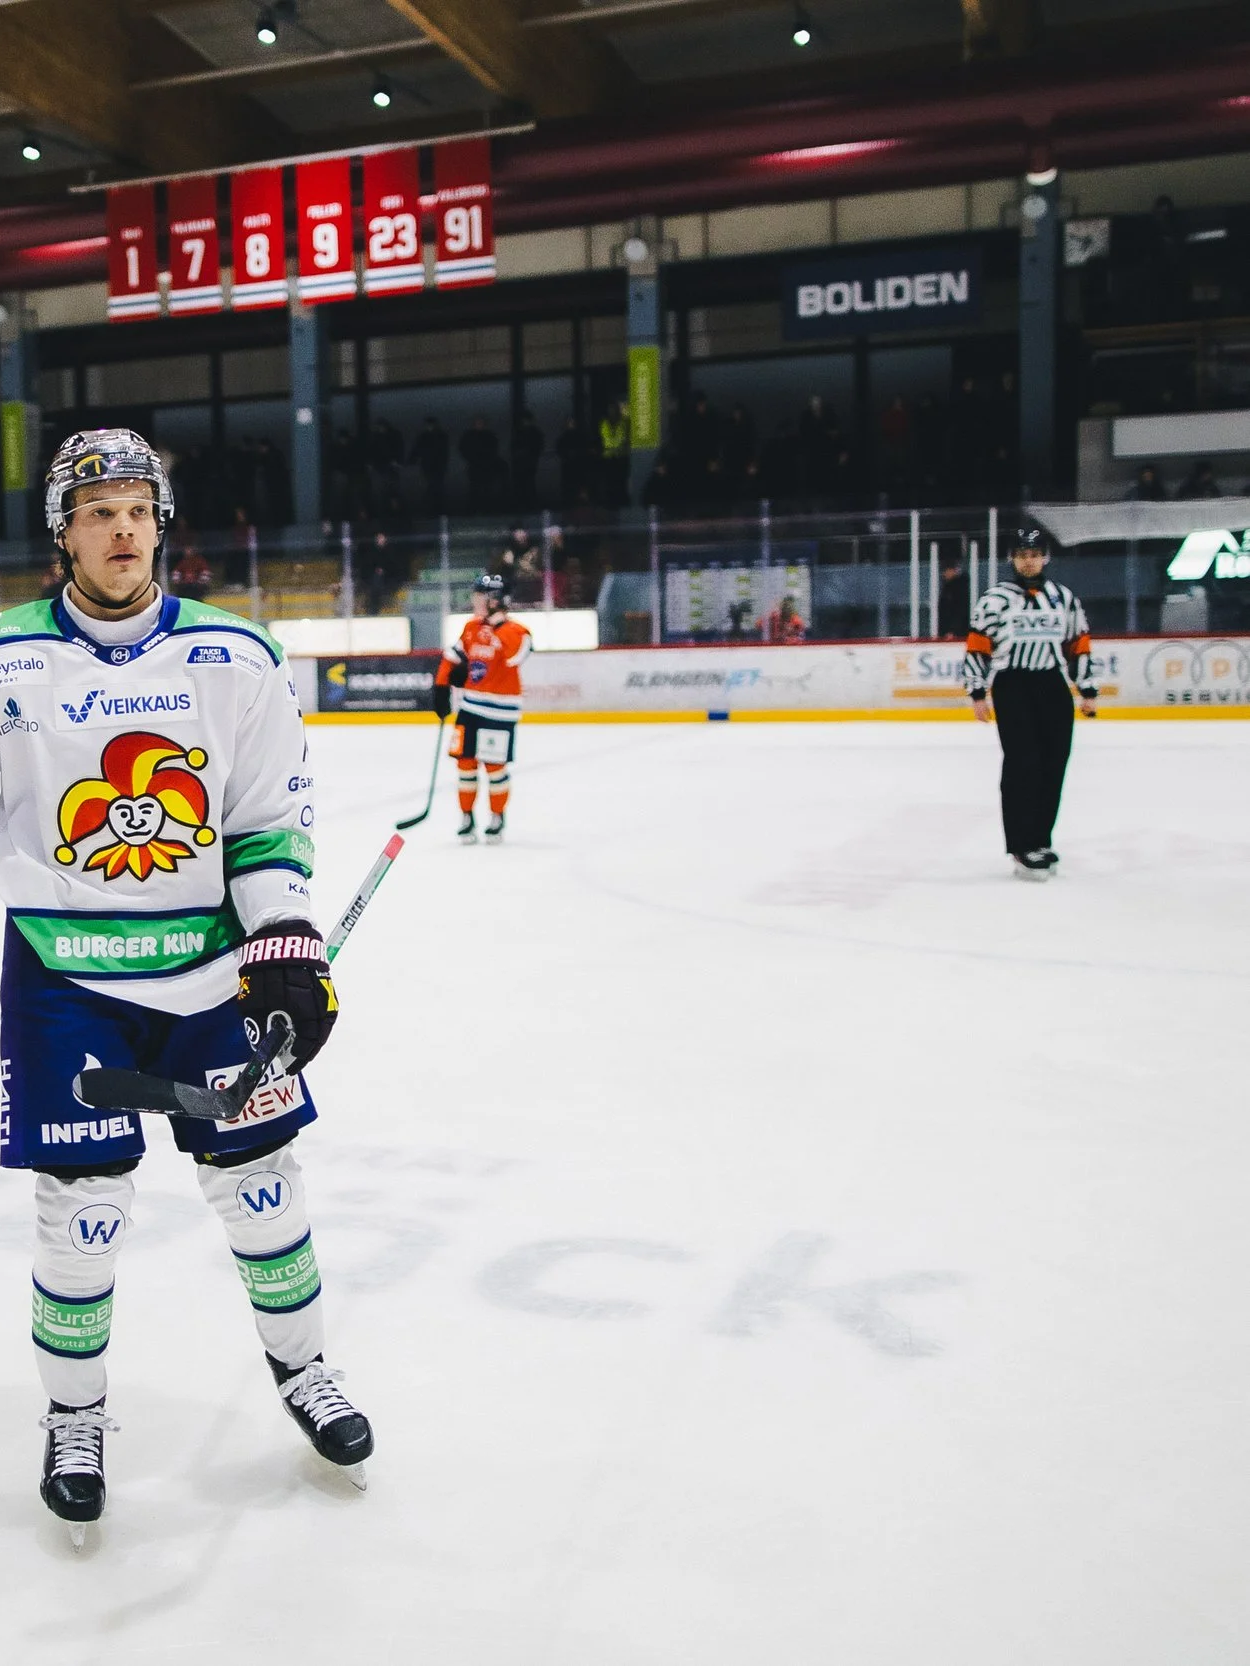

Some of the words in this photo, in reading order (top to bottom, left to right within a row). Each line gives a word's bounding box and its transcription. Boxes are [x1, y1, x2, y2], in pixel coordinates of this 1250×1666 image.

[313, 223, 338, 268] 9
[369, 213, 417, 262] 23
[444, 205, 482, 252] 91
[126, 247, 139, 288] 1
[182, 239, 205, 281] 7
[245, 233, 270, 277] 8
[798, 270, 968, 318] BOLIDEN
[194, 654, 225, 662] HELSINKI
[100, 694, 190, 716] VEIKKAUS
[341, 895, 368, 932] COVERT
[55, 935, 157, 958] BURGER
[225, 1079, 295, 1124] REW
[41, 1115, 135, 1144] INFUEL
[241, 1181, 281, 1213] W
[78, 1218, 121, 1245] W
